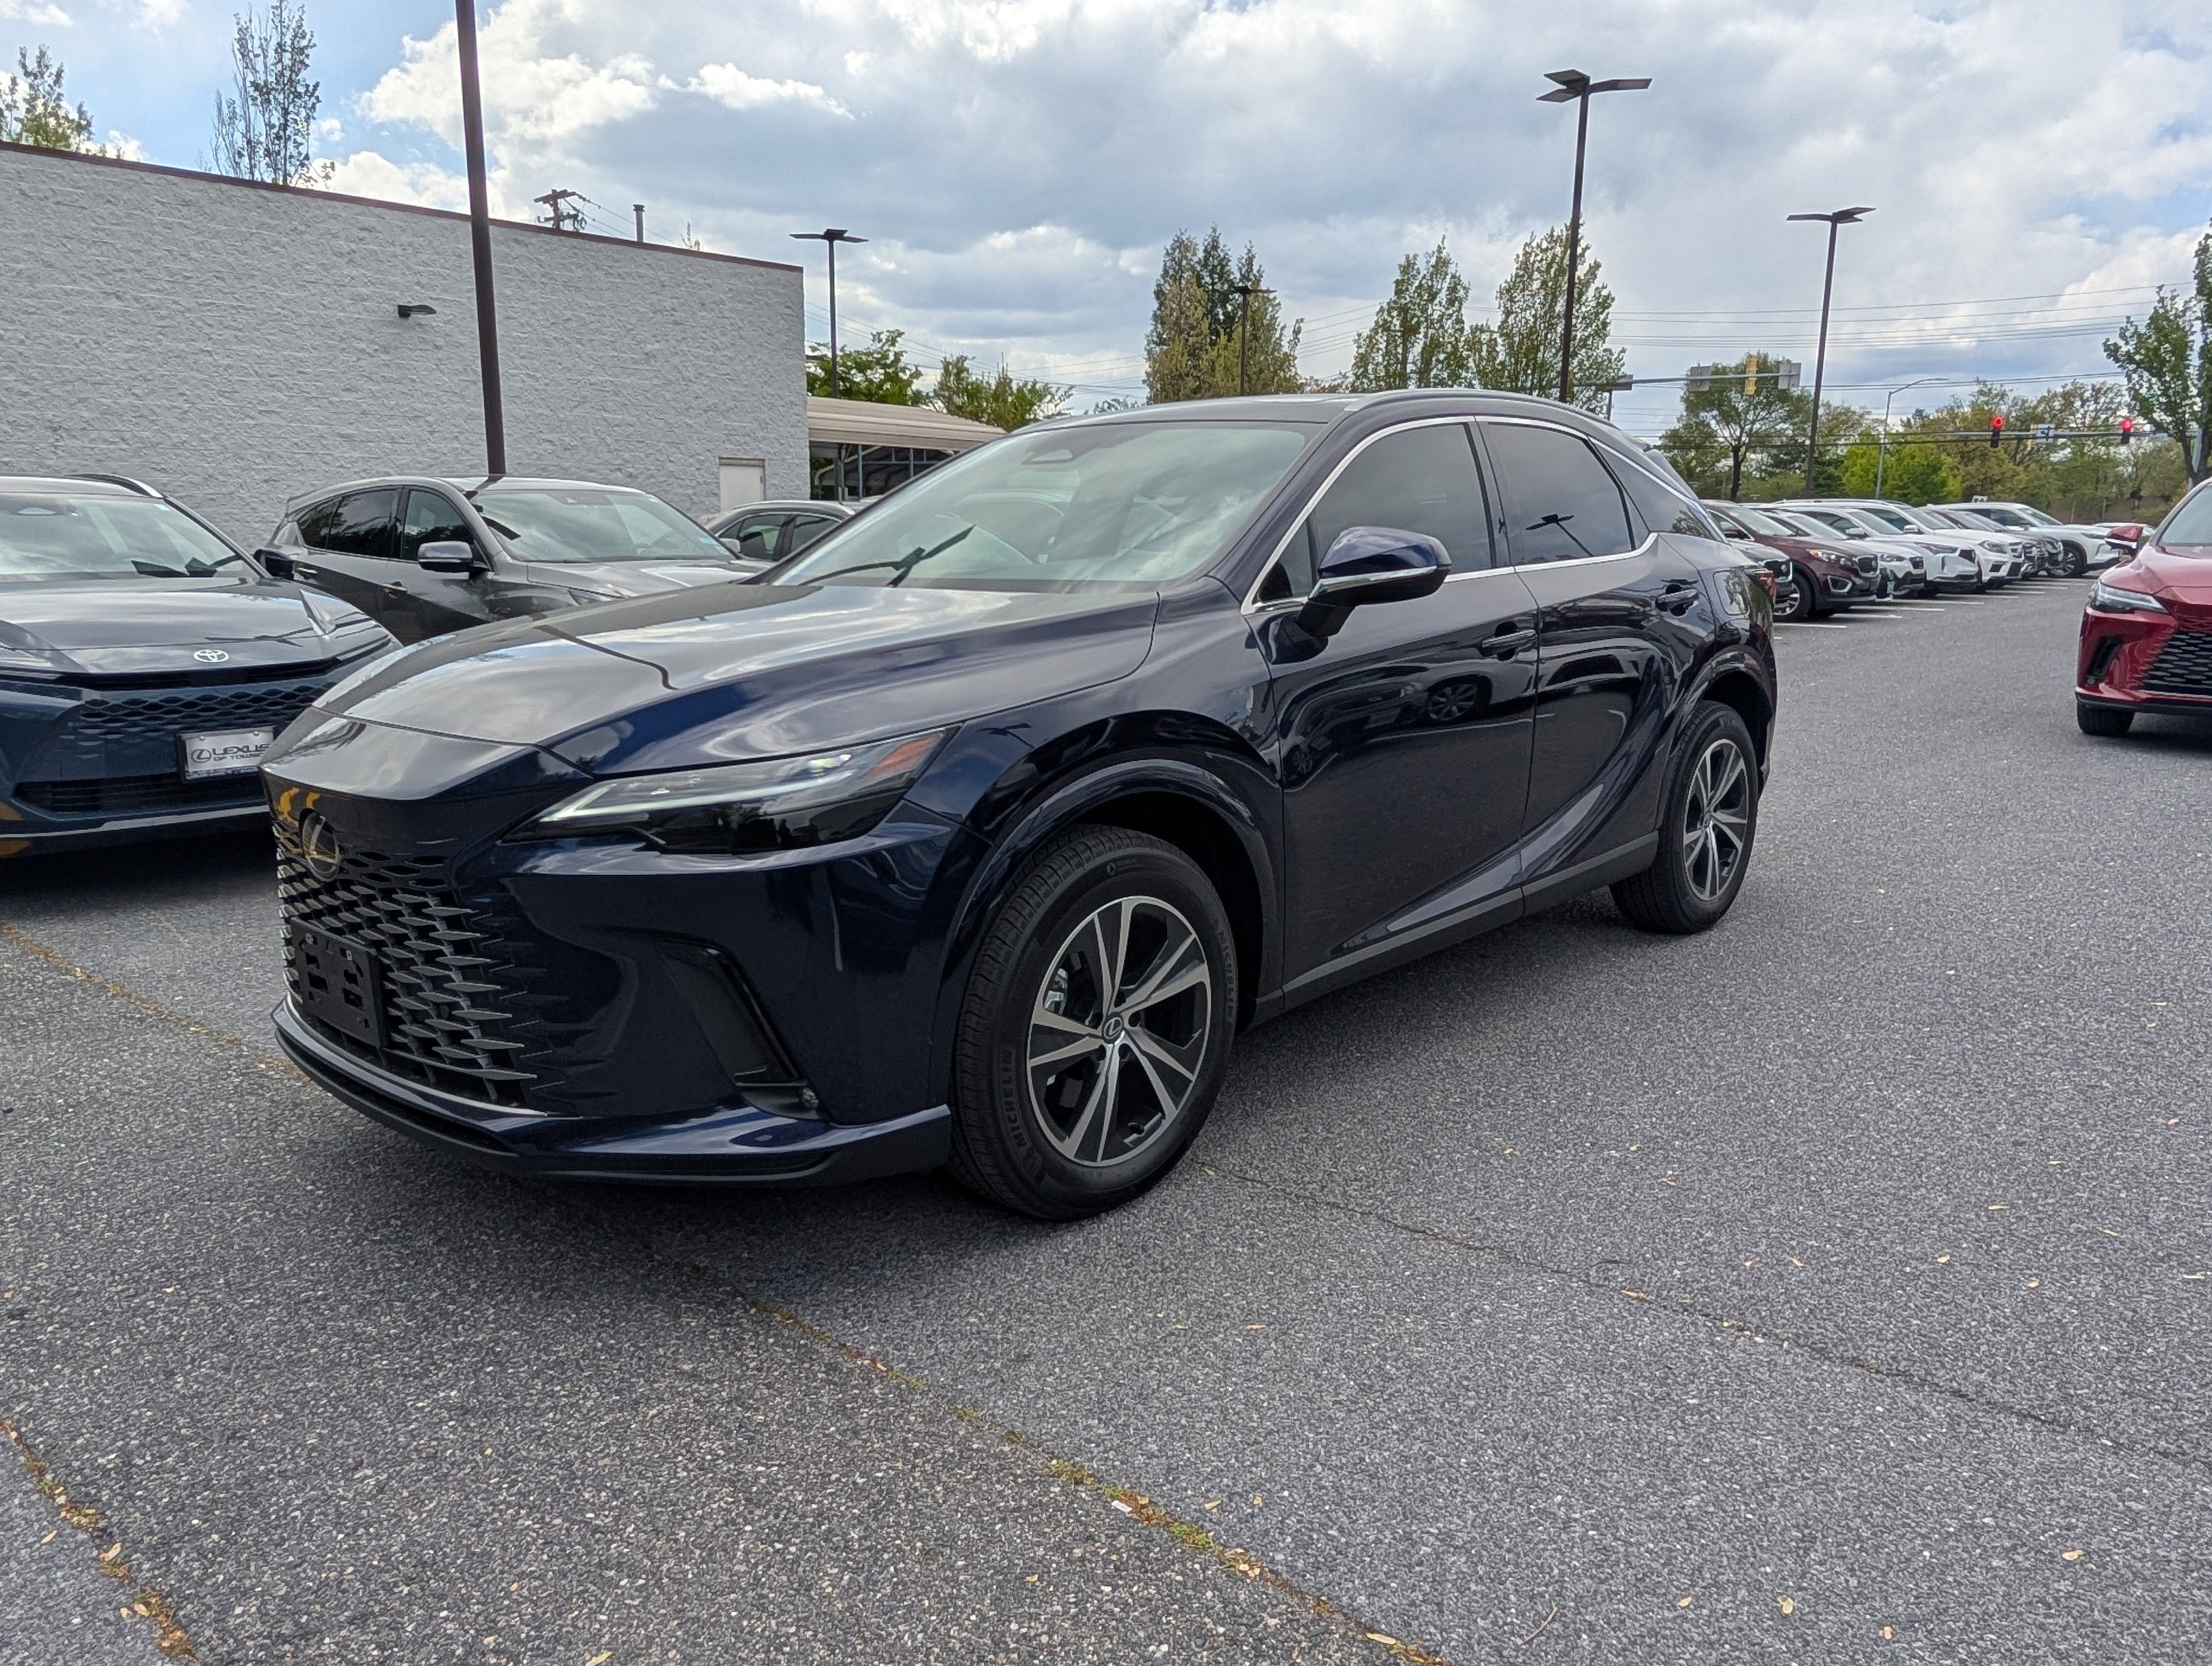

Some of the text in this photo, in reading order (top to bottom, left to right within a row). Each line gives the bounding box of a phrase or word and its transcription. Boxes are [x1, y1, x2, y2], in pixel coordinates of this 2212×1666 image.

[213, 744, 270, 755] LEXUS
[1218, 931, 1234, 1018] MICHELIN
[1002, 1049, 1027, 1148] MICHELIN
